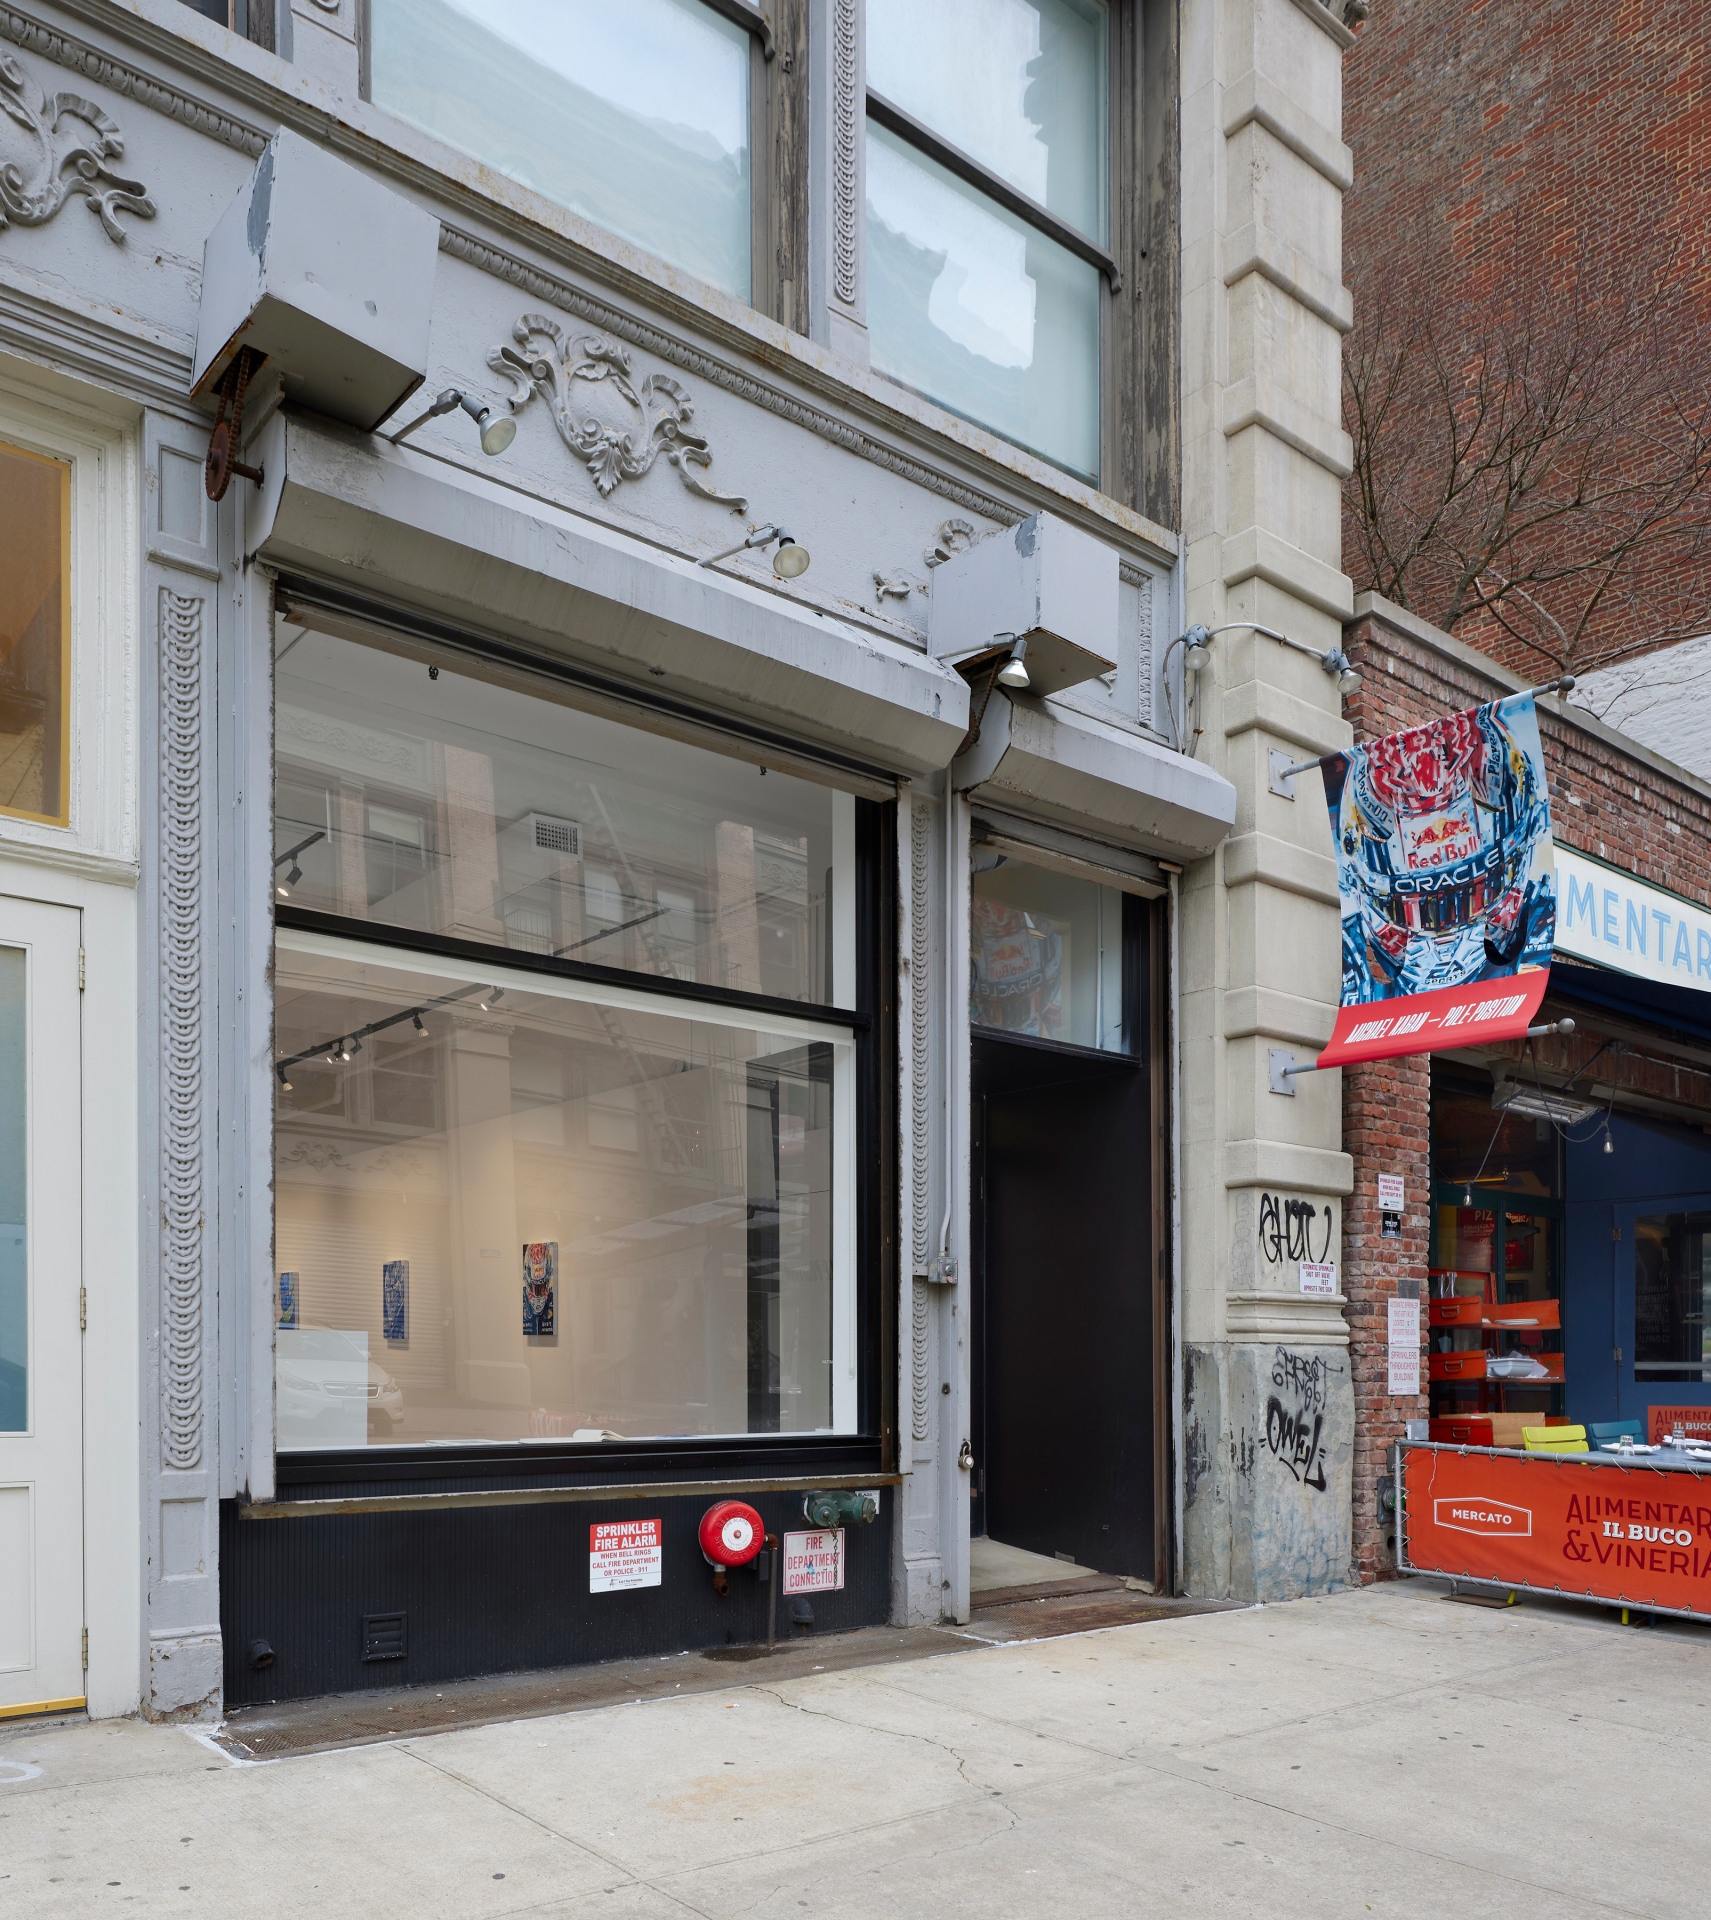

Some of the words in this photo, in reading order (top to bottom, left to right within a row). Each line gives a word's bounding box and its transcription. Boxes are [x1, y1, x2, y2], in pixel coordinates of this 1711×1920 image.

[1408, 847, 1442, 871] Red
[1447, 836, 1478, 862] Bull
[1395, 848, 1500, 893] ORACLE
[1344, 1018, 1394, 1044] MICHAEL
[1438, 1003, 1476, 1028] POLE
[1467, 993, 1527, 1023] POSITION
[1391, 1351, 1417, 1359] SPRINKLERS
[1390, 1361, 1418, 1370] THROUGHOUT
[1656, 1410, 1711, 1425] ALIMENT
[1673, 1422, 1684, 1430] IL
[1452, 1508, 1512, 1525] MERCATO
[596, 1522, 655, 1537] SPRINKLER
[1602, 1521, 1625, 1539] IL
[1628, 1523, 1693, 1547] BUCO
[595, 1538, 619, 1551] FIRE
[621, 1534, 657, 1548] ALARM
[806, 1536, 823, 1550] FIRE
[622, 1556, 659, 1566] DEPARTMENT
[788, 1552, 840, 1570] DEPARTMENT
[614, 1567, 633, 1575] POLICE
